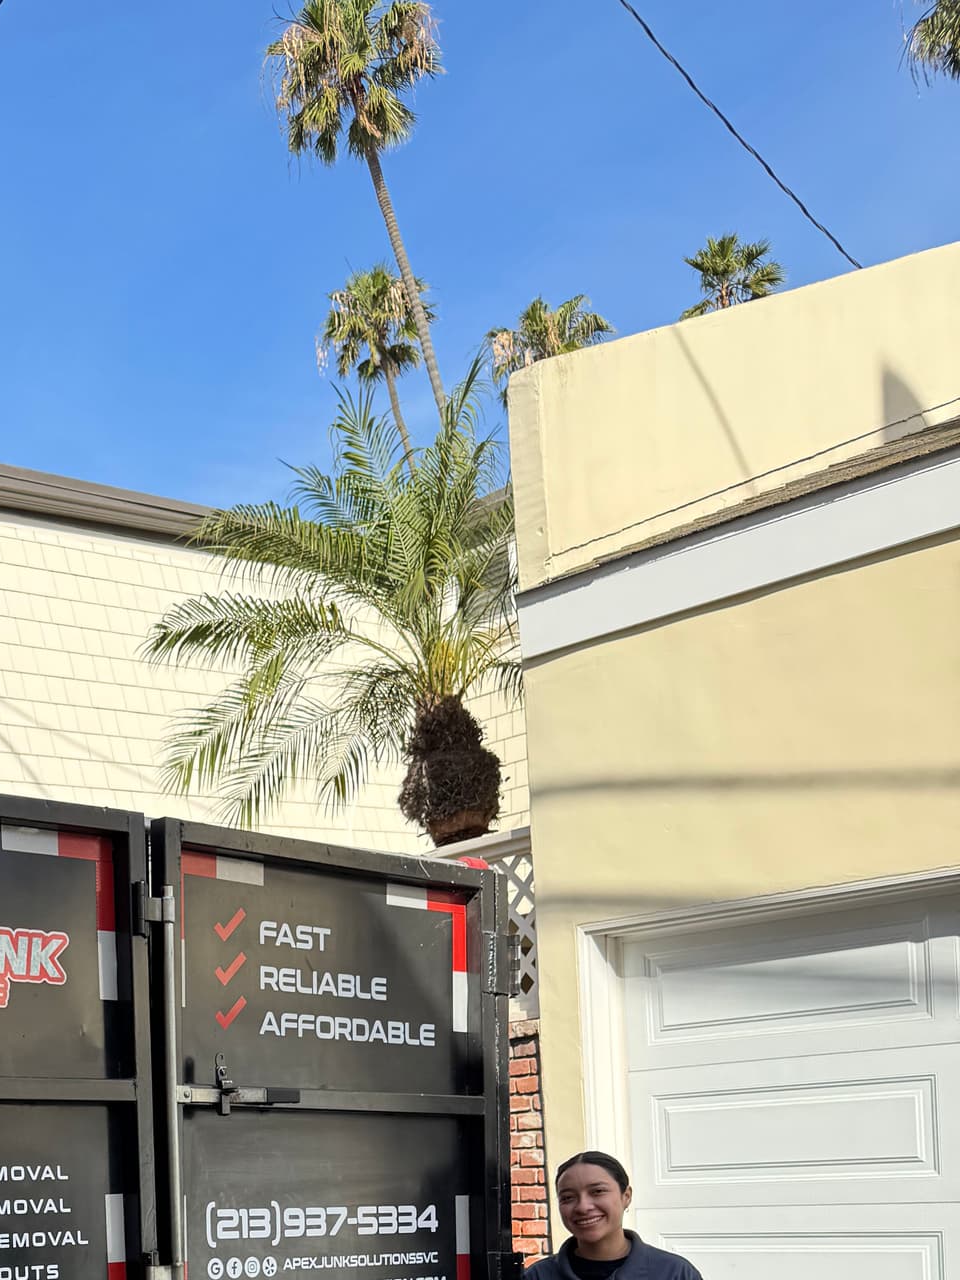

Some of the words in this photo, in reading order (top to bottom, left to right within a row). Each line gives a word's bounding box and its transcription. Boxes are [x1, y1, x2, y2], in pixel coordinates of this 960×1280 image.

[259, 920, 331, 952] FAST
[259, 965, 388, 1001] RELIABLE
[259, 1010, 436, 1047] AFFORDABLE
[206, 1201, 439, 1249] (213)937-5334
[283, 1251, 439, 1271] APEXJUNKSOLUTIONSSVC
